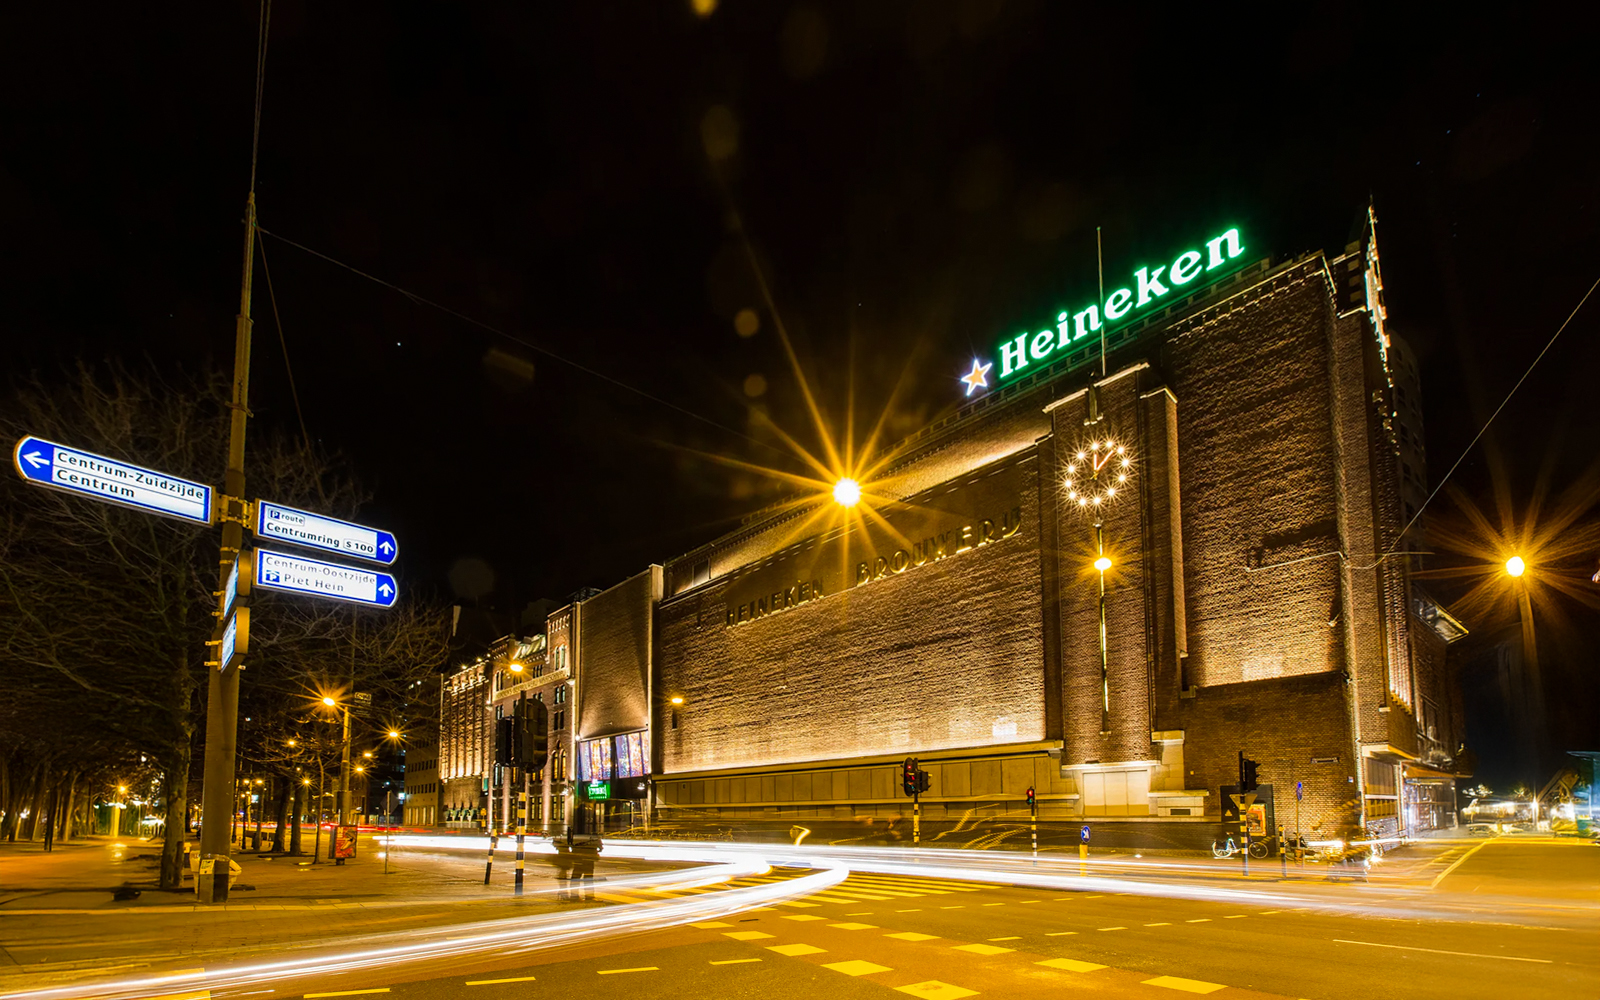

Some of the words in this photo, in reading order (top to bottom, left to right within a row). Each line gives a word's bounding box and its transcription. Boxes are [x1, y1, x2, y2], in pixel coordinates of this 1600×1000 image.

[1000, 228, 1245, 378] Heineken
[56, 469, 135, 498] Centrum
[57, 452, 203, 499] Centrum-Zuidzijde
[281, 513, 304, 524] route
[266, 522, 340, 547] Centrumring
[346, 540, 352, 548] S
[354, 542, 374, 554] 100
[266, 556, 375, 584] Centrum-Oostzijde
[284, 573, 310, 586] Piet
[315, 579, 344, 591] Hein
[726, 579, 825, 630] HEINEKEN
